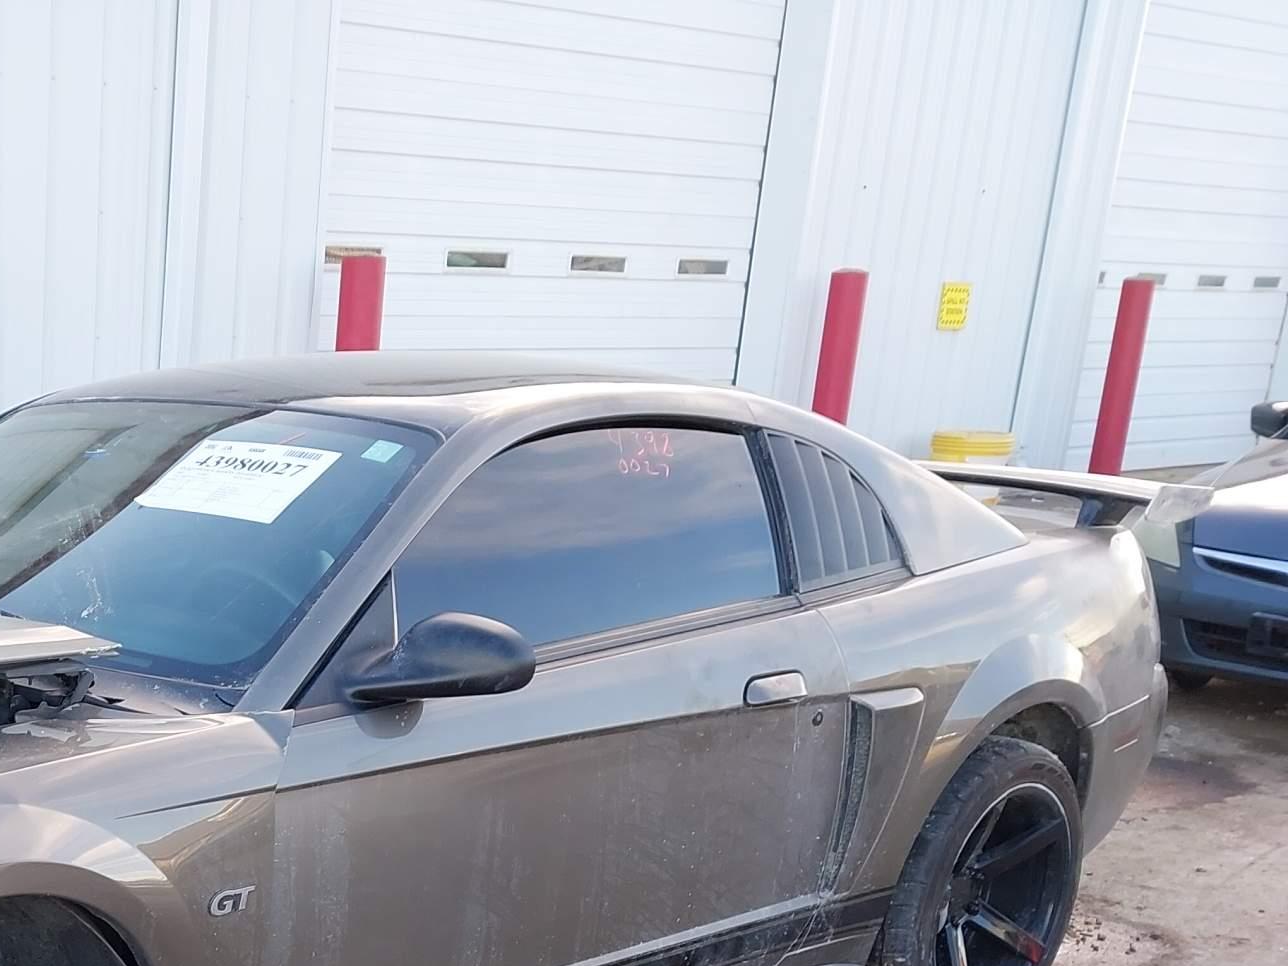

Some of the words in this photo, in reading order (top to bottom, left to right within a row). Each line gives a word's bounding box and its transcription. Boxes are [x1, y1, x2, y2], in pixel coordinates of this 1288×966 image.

[195, 454, 307, 477] 43980027
[618, 458, 669, 477] 0027
[208, 884, 256, 917] GT
